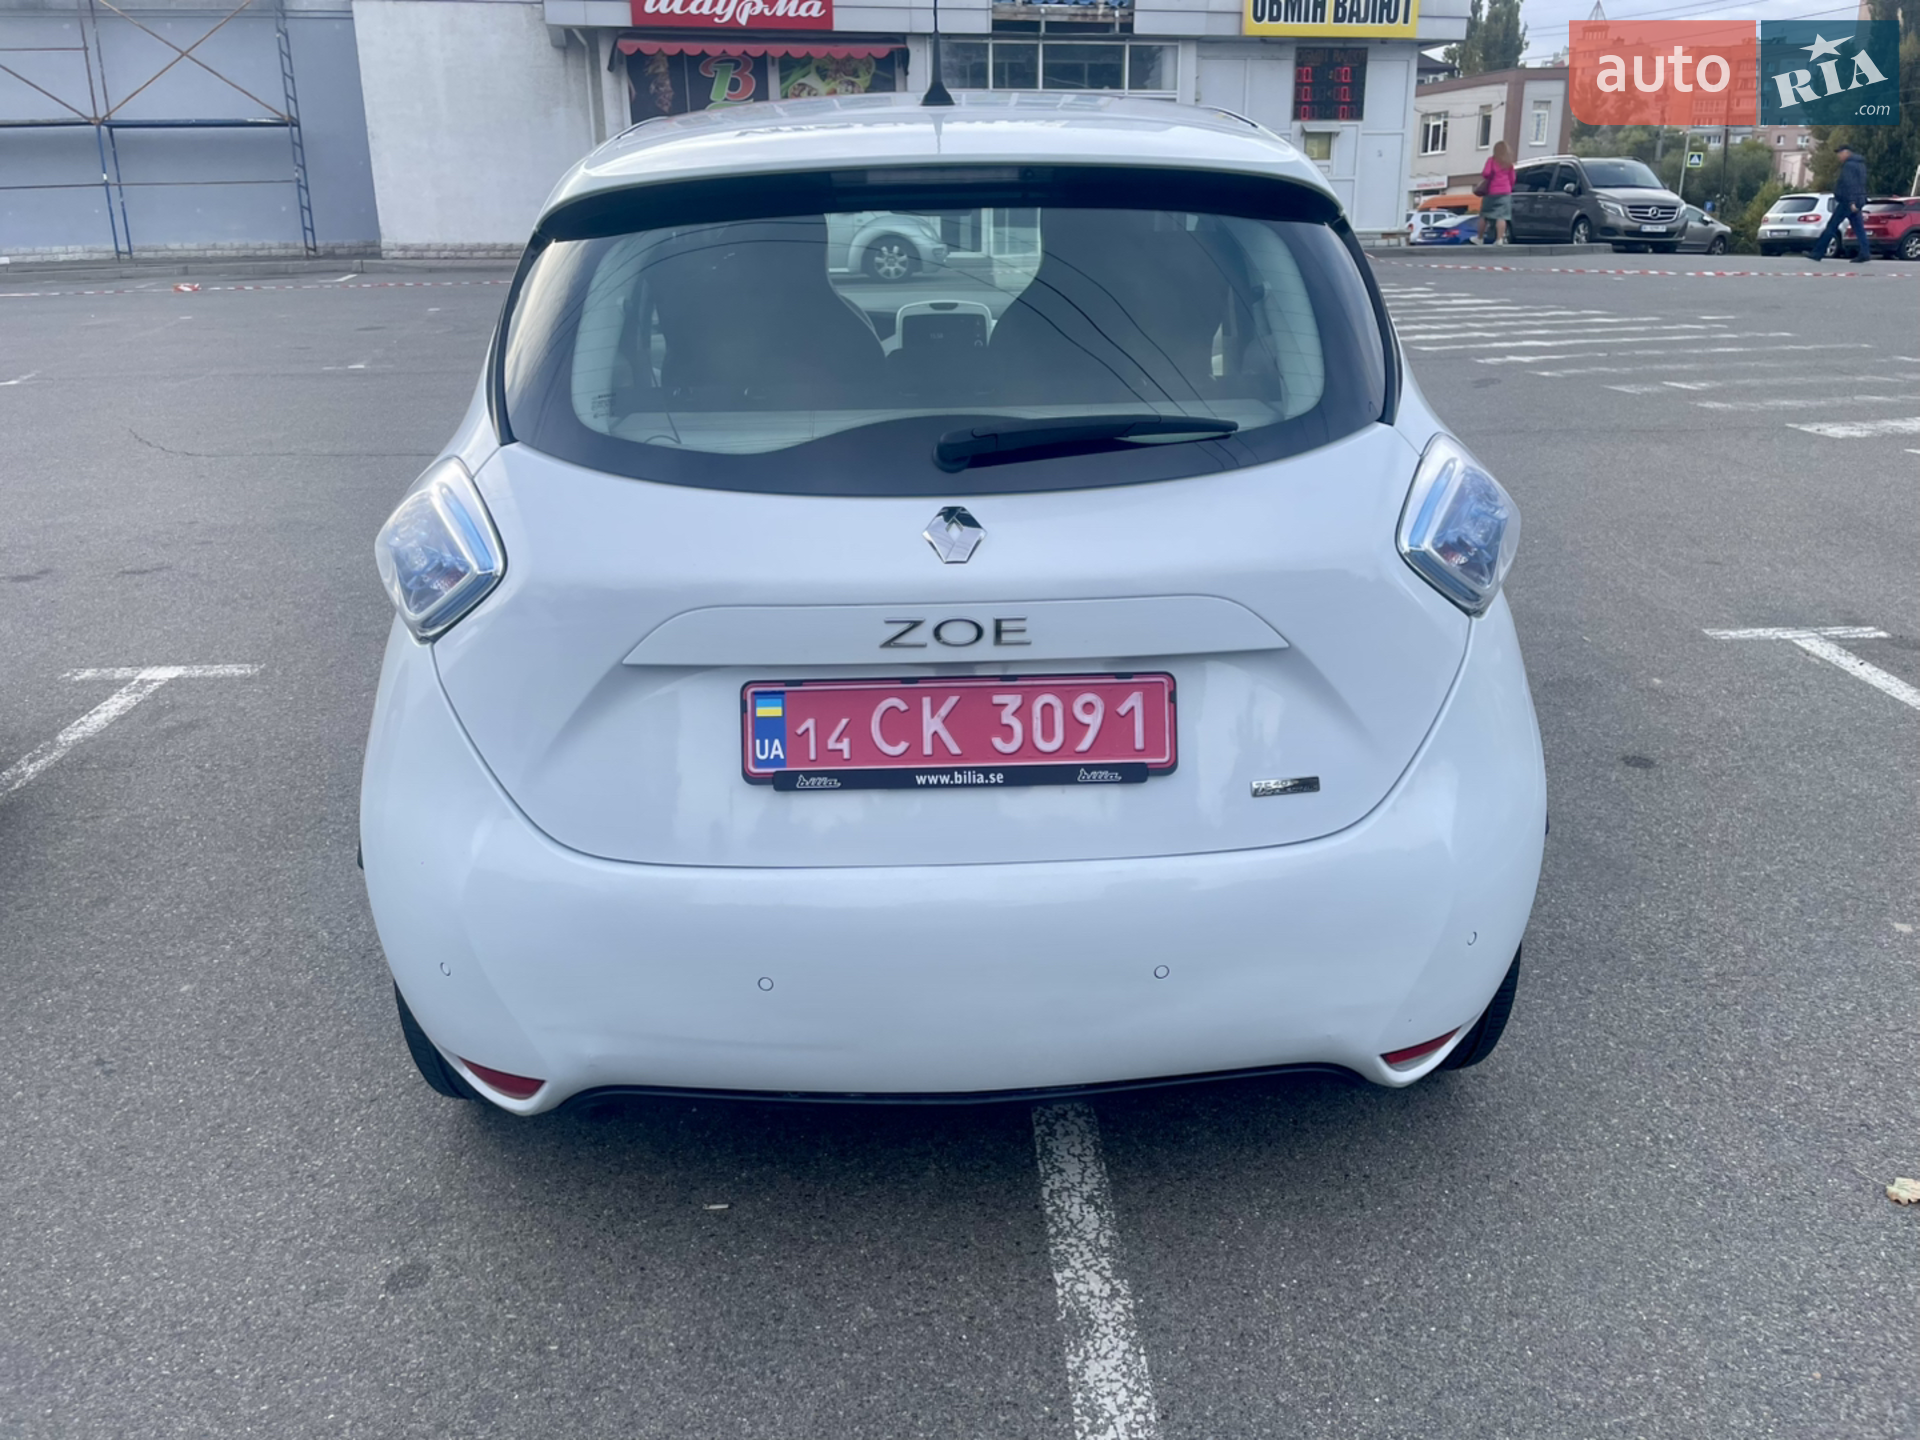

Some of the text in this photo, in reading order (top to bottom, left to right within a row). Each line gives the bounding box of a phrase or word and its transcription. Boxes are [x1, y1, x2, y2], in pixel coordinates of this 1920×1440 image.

[879, 616, 1032, 648] ZOE
[795, 692, 1145, 761] 14 CK 3091
[755, 739, 785, 760] UA
[915, 770, 1004, 785] www.bilia.se
